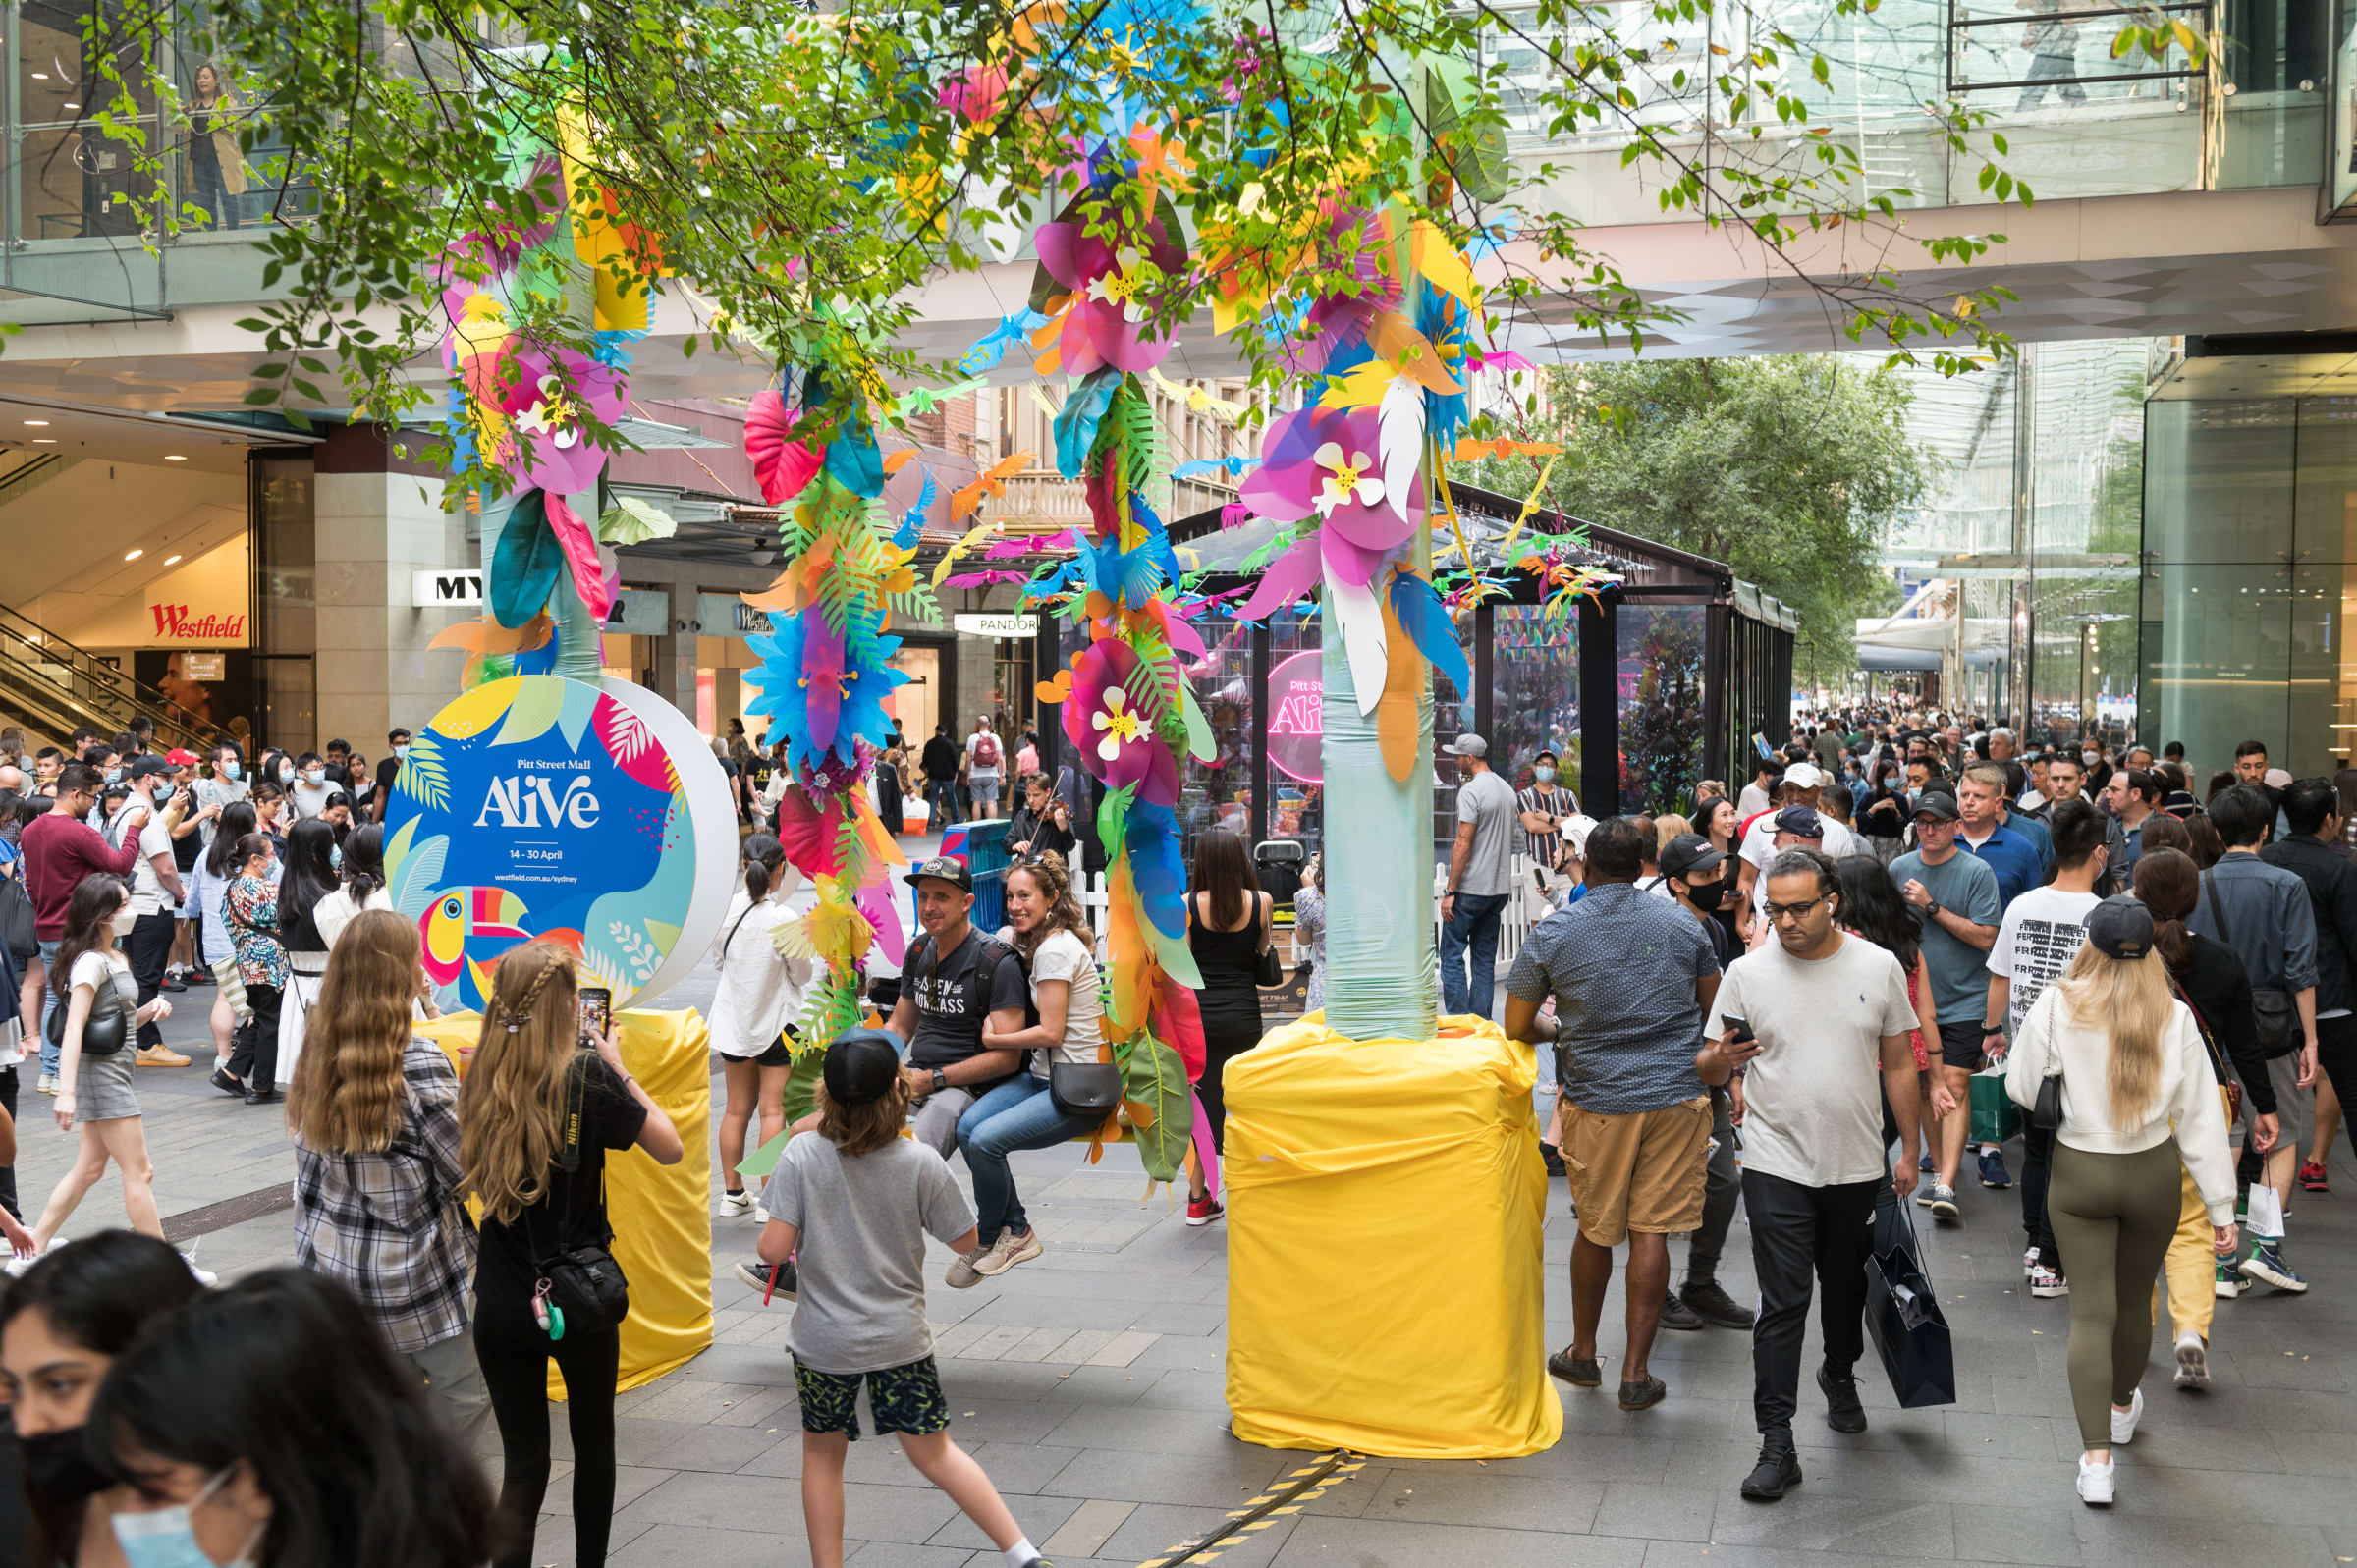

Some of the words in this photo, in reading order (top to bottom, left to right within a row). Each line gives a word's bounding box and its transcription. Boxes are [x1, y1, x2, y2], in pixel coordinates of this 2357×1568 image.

[149, 604, 246, 638] Westfield
[1289, 680, 1308, 692] Pitt
[1268, 695, 1324, 734] Ali
[517, 759, 534, 769] Pitt
[536, 759, 566, 769] Street
[568, 760, 591, 770] Mall
[510, 850, 520, 859] 14
[527, 850, 539, 859] 30
[540, 850, 563, 862] April
[494, 874, 577, 884] westfield.com.au/sydney
[919, 975, 953, 995] ASEN
[567, 1113, 578, 1145] Nikon
